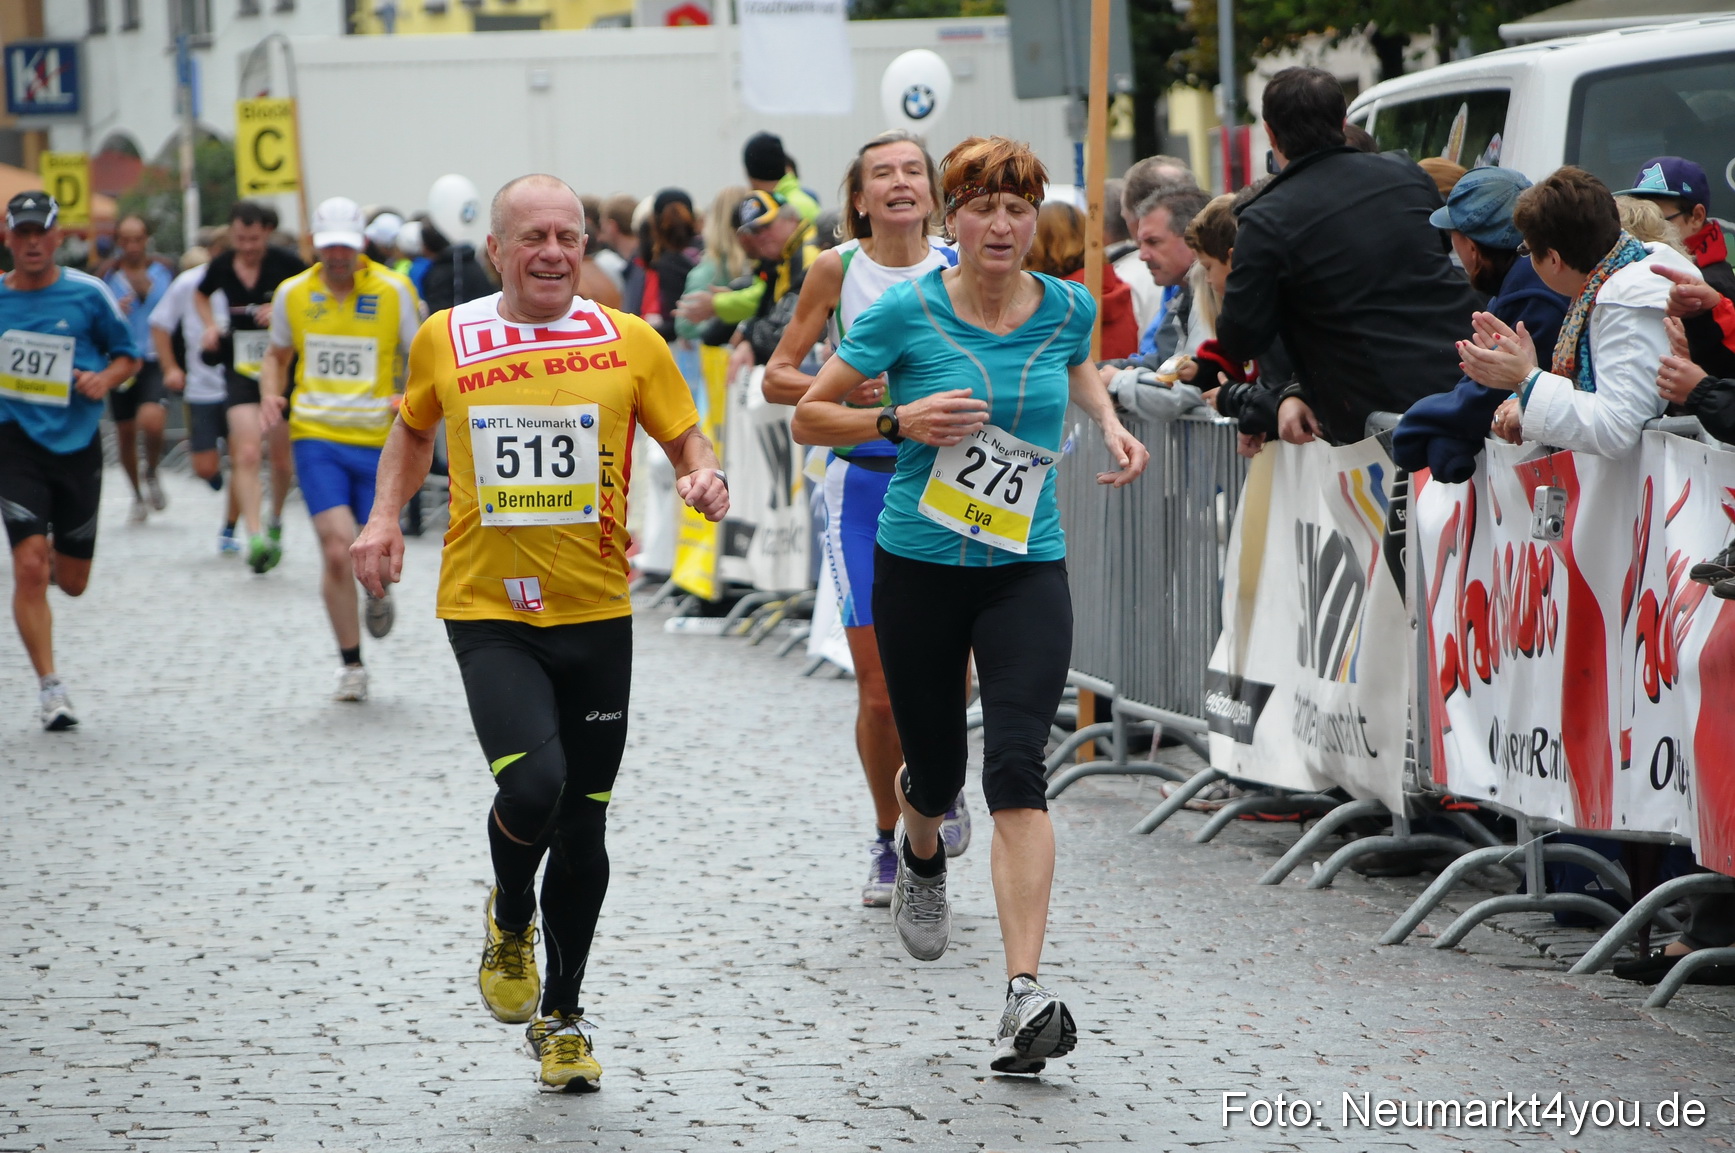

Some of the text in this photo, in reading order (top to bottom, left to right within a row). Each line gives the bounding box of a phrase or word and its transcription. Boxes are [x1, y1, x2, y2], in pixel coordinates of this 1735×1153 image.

[252, 129, 283, 173] C
[56, 174, 80, 208] D
[11, 347, 58, 376] 297
[317, 351, 361, 376] 565
[456, 350, 628, 395] MAX BÖGL
[516, 417, 577, 430] Neumarkt
[496, 434, 576, 479] 513
[955, 445, 1029, 505] 275
[497, 490, 574, 508] Bernhard
[963, 502, 993, 527] Eva
